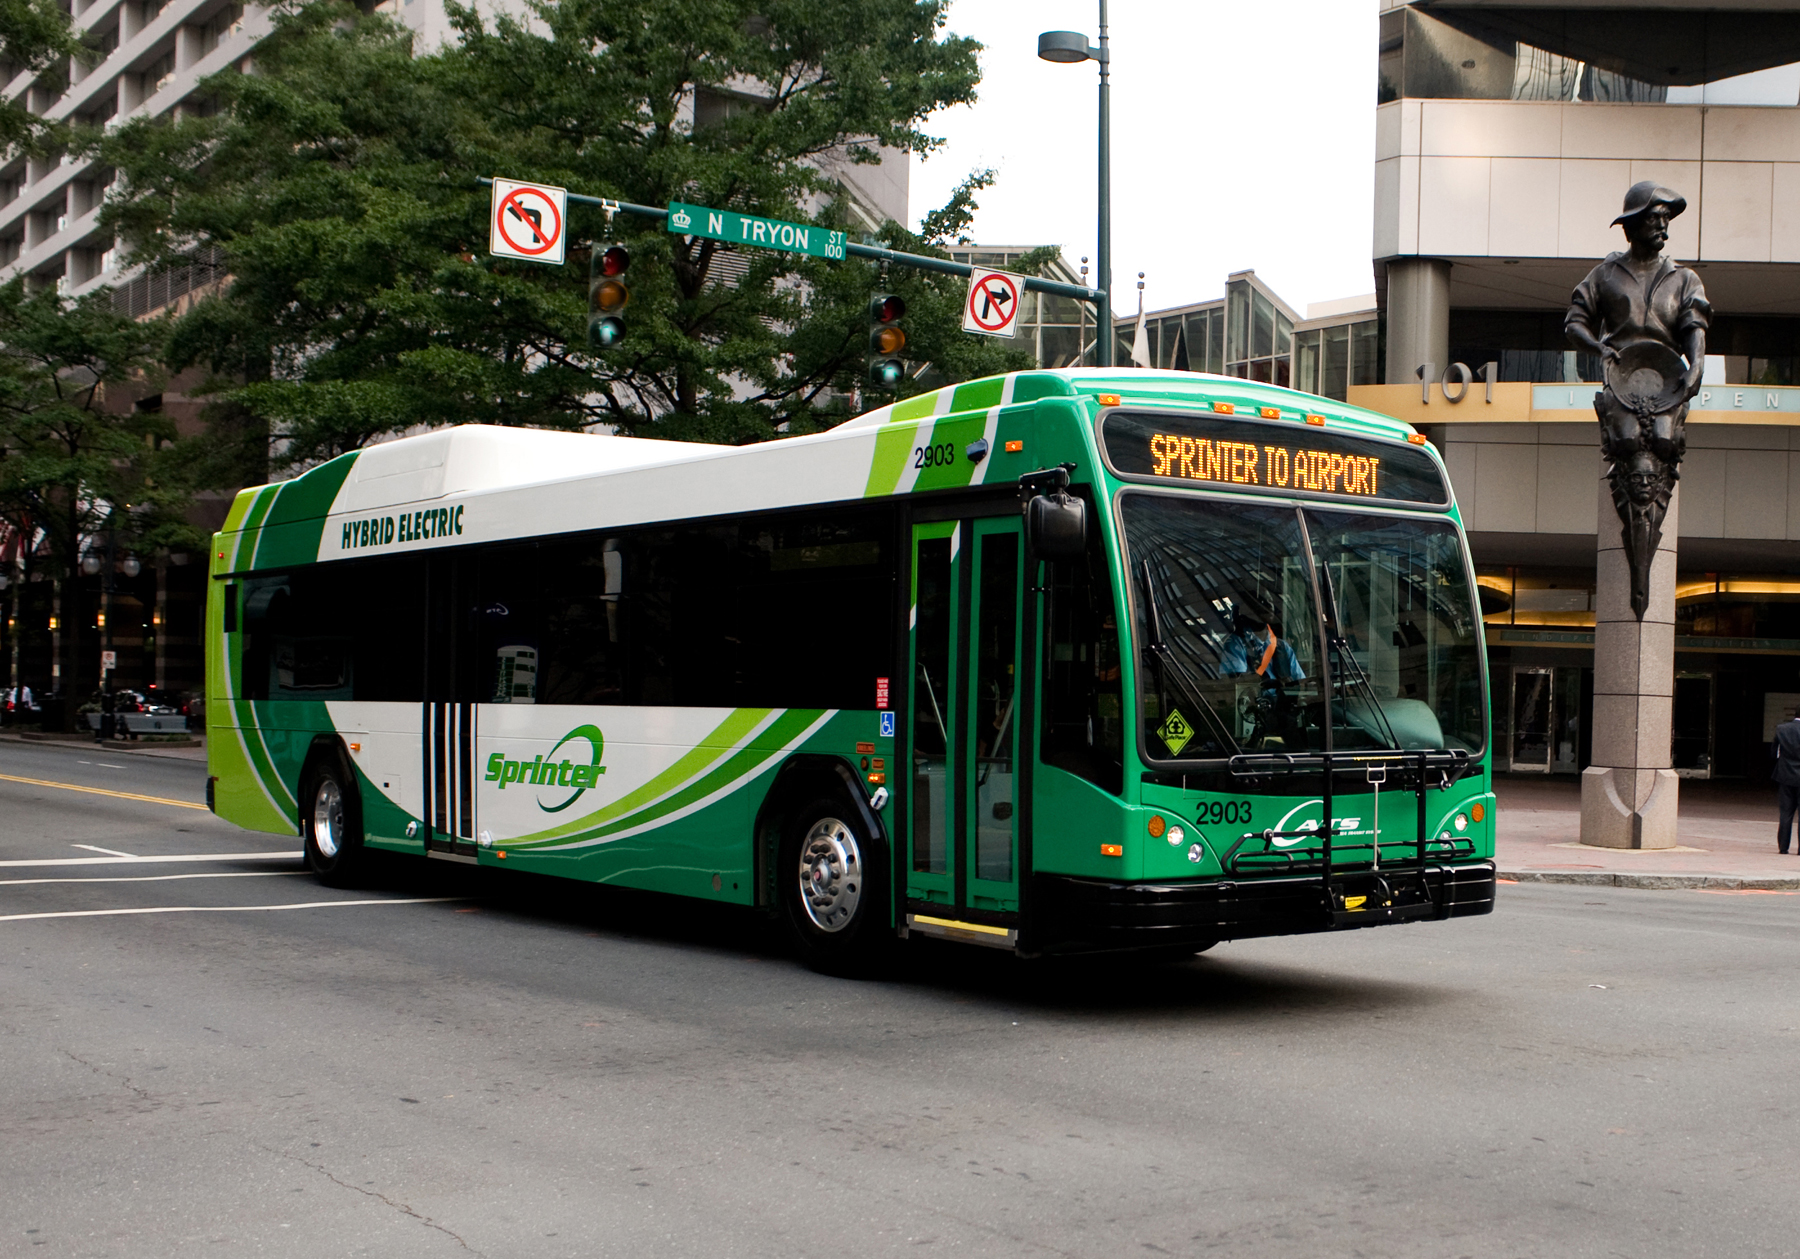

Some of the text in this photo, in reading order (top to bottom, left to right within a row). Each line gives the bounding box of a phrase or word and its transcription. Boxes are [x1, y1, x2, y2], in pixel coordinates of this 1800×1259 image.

[708, 212, 844, 250] N TRYON ST
[824, 243, 843, 259] 100
[1415, 361, 1498, 405] 101
[914, 442, 955, 470] 2903
[1150, 433, 1380, 496] SPRINTER TO AIRPORT
[341, 504, 464, 549] HYBRID ELECTRIC
[484, 752, 607, 790] Sprinter
[1195, 800, 1253, 826] 2903
